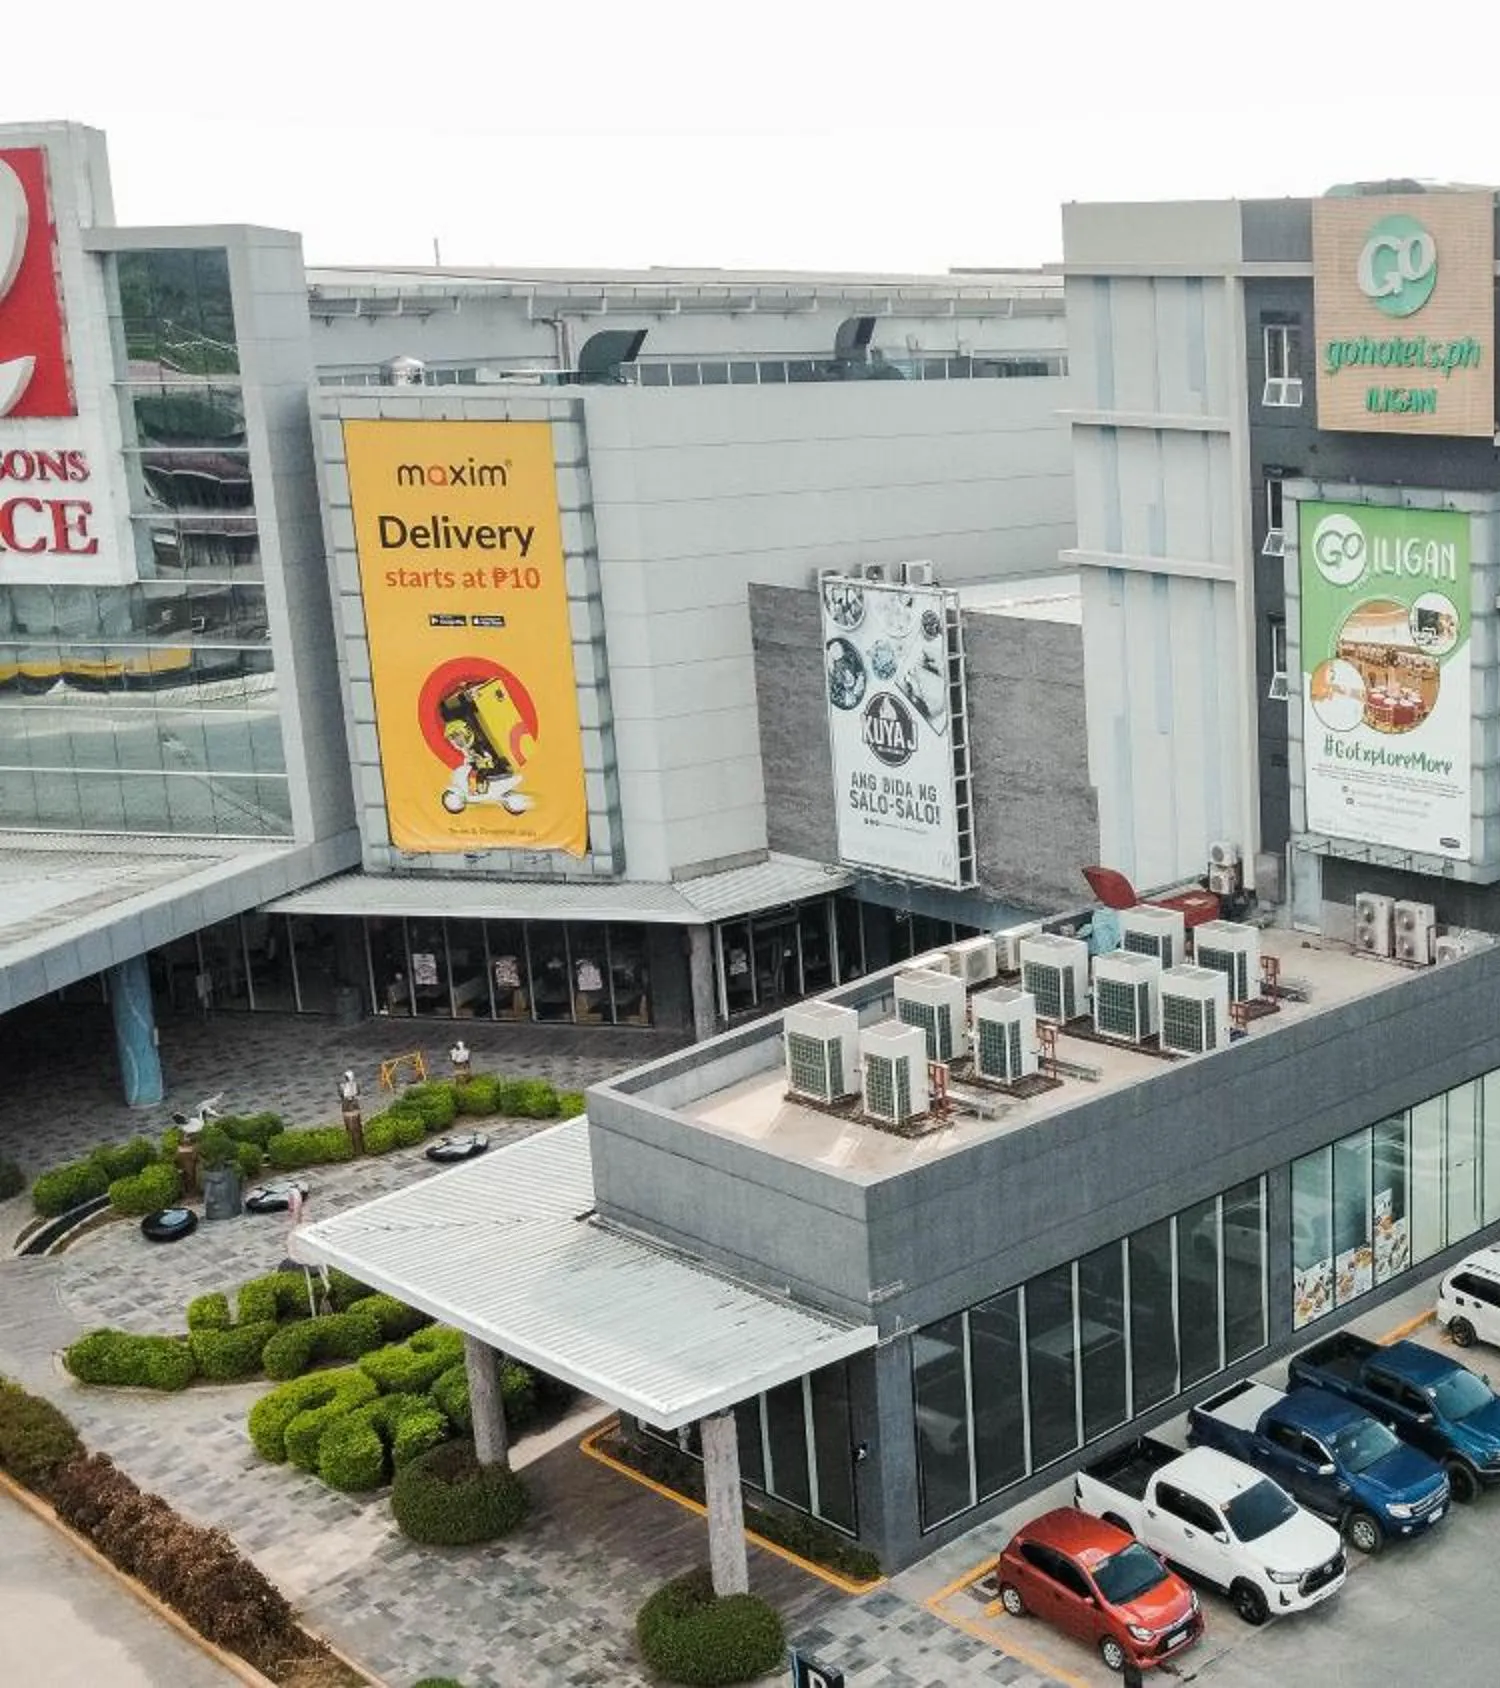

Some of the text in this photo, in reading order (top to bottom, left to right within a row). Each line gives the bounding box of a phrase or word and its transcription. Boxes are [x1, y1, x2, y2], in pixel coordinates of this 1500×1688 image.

[0, 449, 90, 482] ONS
[397, 457, 507, 487] maxim
[0, 497, 99, 555] CE
[378, 515, 535, 557] Delivery
[385, 567, 455, 588] starts
[462, 569, 487, 588] at
[1373, 536, 1456, 583] ILIGAN
[862, 714, 906, 750] KUYA
[1323, 733, 1453, 775] #GoExploreMore
[851, 771, 937, 803] ANG BIDA NG
[850, 789, 941, 825] SALO-SALO!
